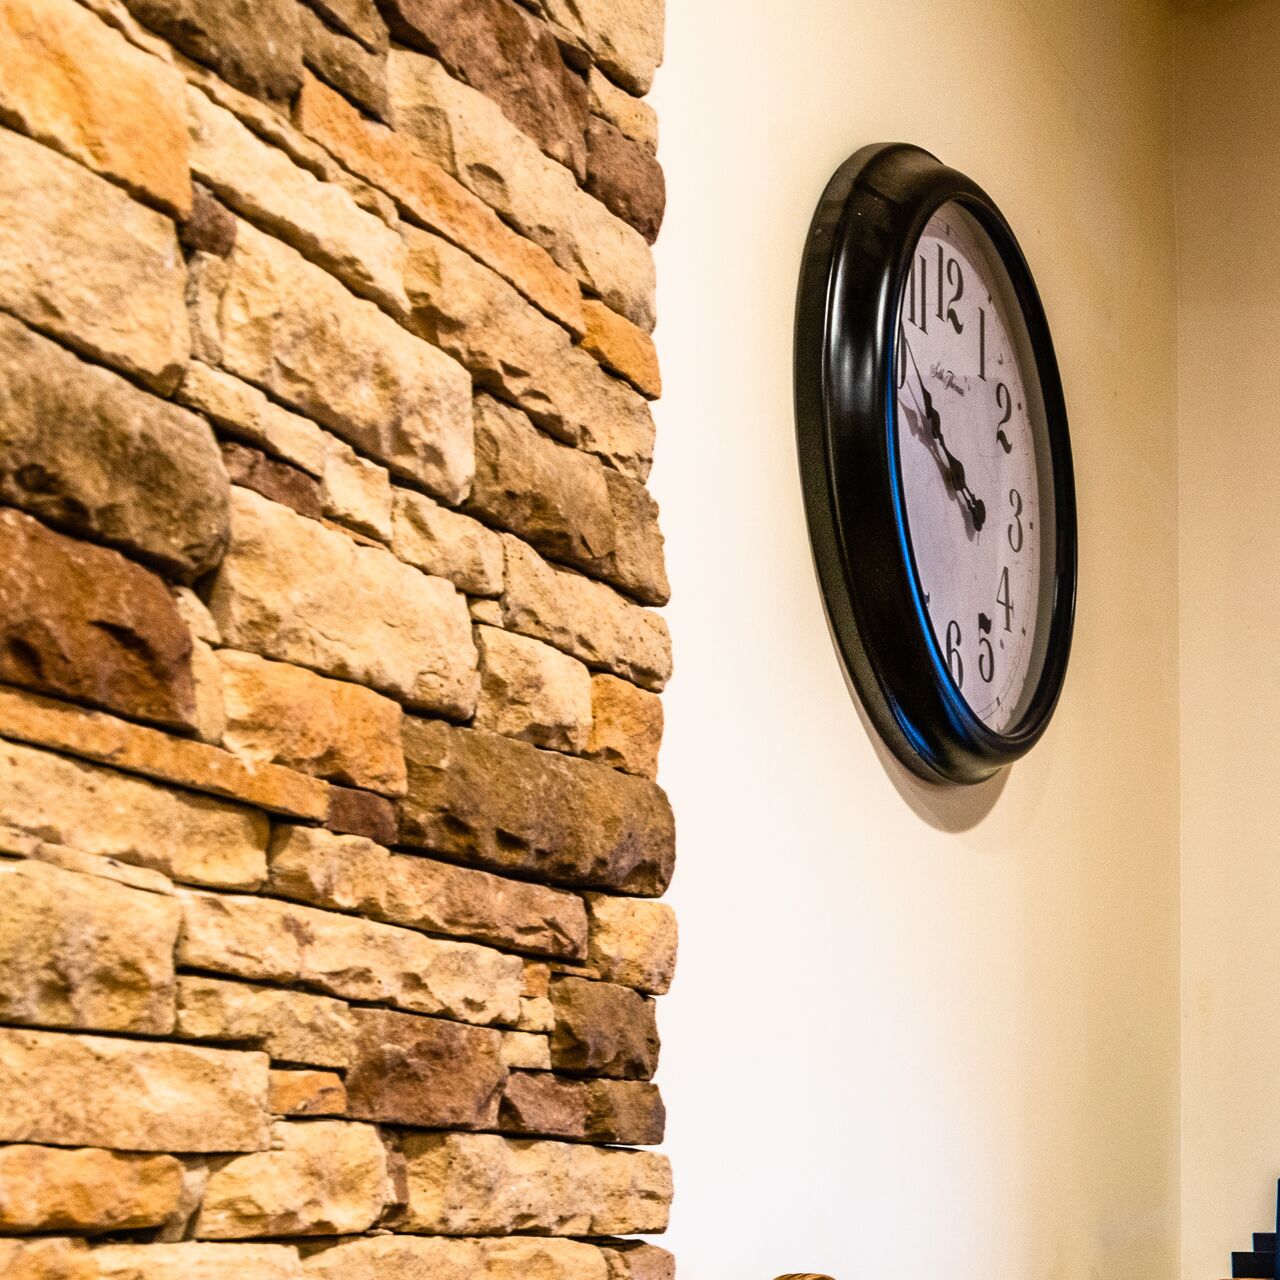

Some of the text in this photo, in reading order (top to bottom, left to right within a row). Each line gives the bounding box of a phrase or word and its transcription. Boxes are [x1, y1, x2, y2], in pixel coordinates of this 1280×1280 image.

[936, 243, 964, 335] 12
[996, 382, 1012, 454] 2
[1008, 489, 1023, 553] 3
[996, 566, 1014, 633] 4
[978, 612, 995, 683] 5
